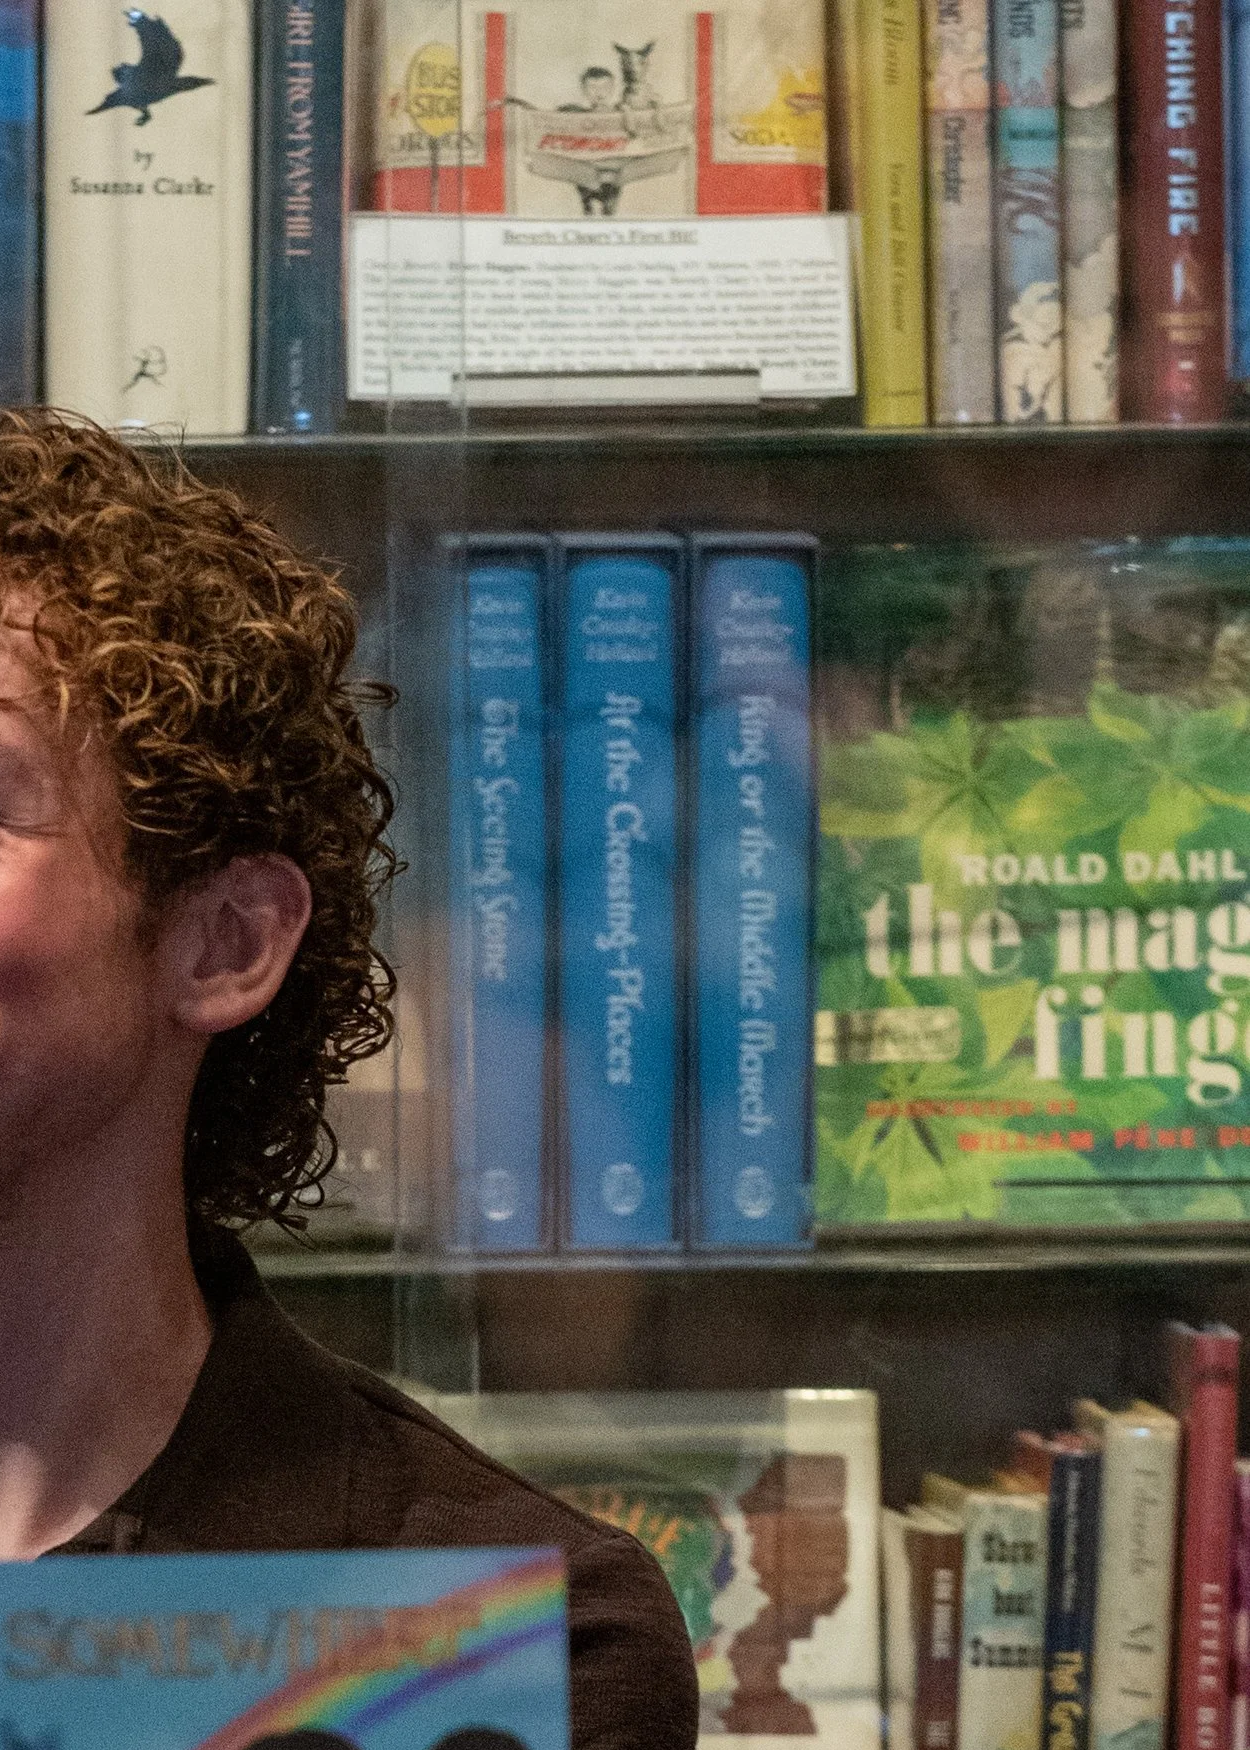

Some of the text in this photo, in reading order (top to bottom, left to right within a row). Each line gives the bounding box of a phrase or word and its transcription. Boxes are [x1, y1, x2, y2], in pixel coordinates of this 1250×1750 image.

[285, 61, 315, 140] FROM
[1163, 0, 1200, 237] CHING FIRE
[69, 176, 215, 197] Susanna Clarke
[134, 150, 154, 169] by
[957, 848, 1248, 887] ROALD DAHL
[861, 883, 1024, 979] the
[1034, 982, 1250, 1107] fing
[1196, 1583, 1222, 1691] LITTLE
[1195, 1705, 1219, 1750] BO
